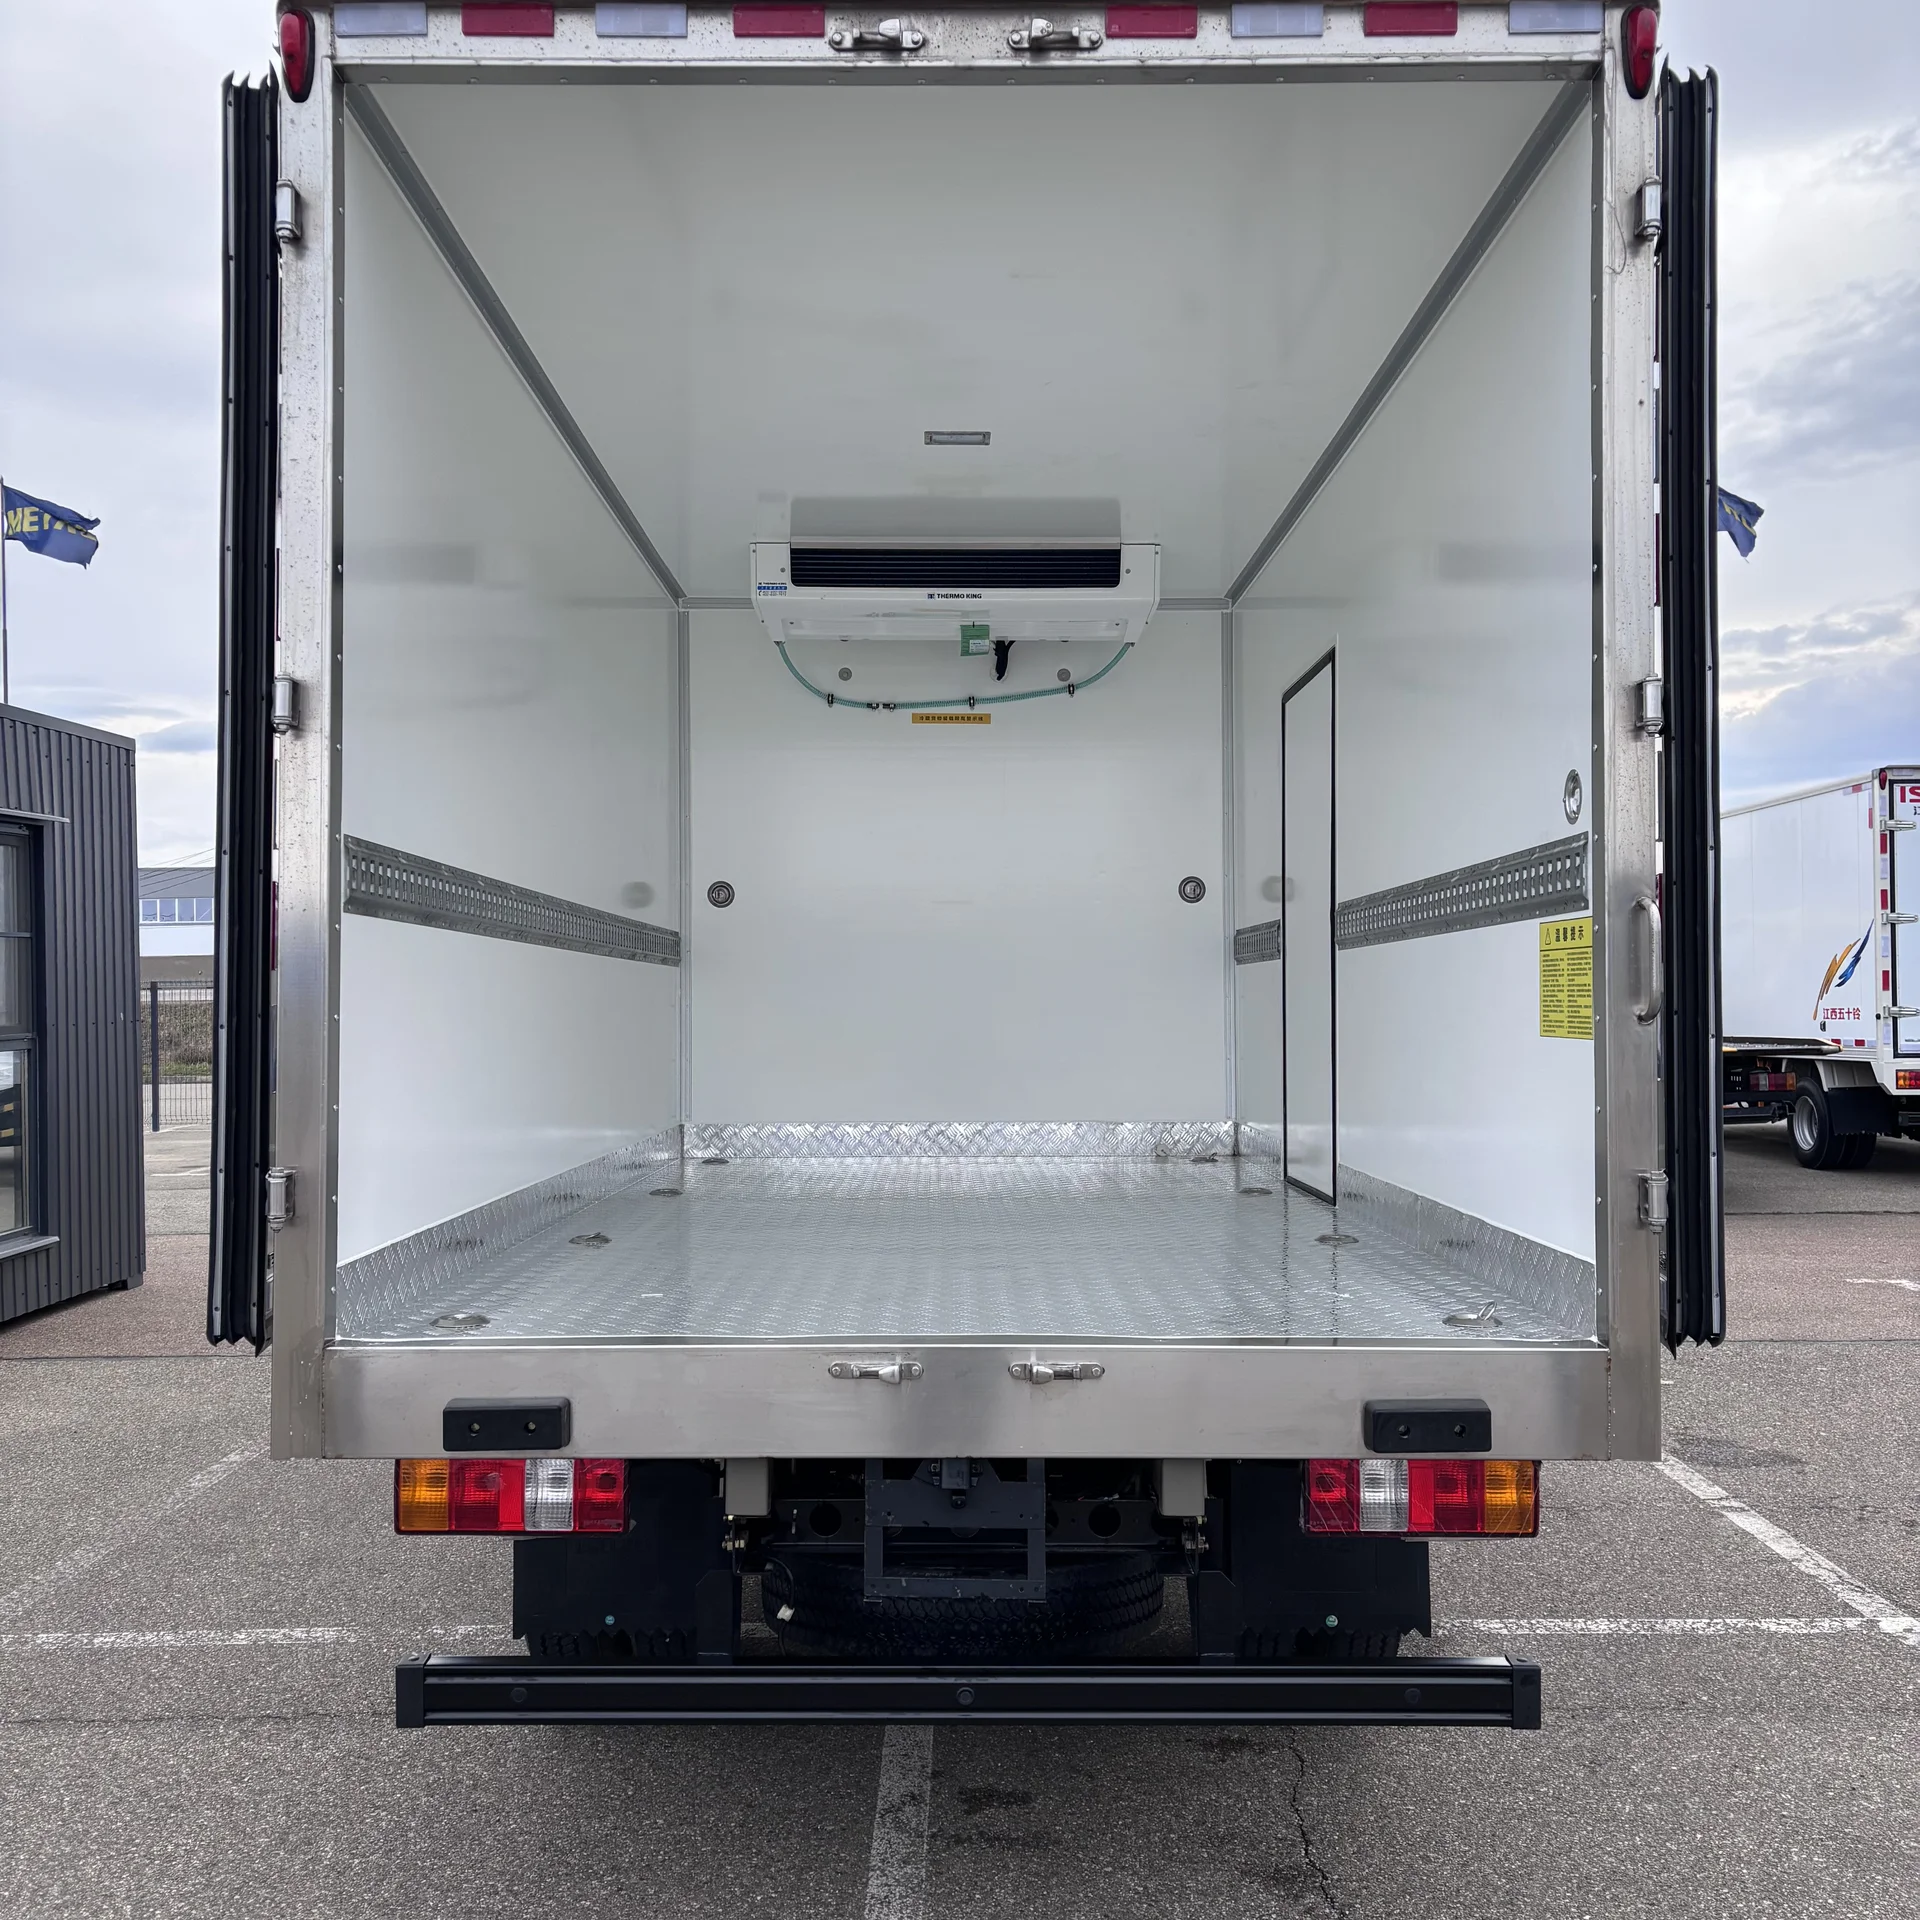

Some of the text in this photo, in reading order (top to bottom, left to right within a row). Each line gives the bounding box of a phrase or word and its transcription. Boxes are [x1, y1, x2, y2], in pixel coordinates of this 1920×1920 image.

[1823, 1007, 1861, 1020] 江西五十铃
